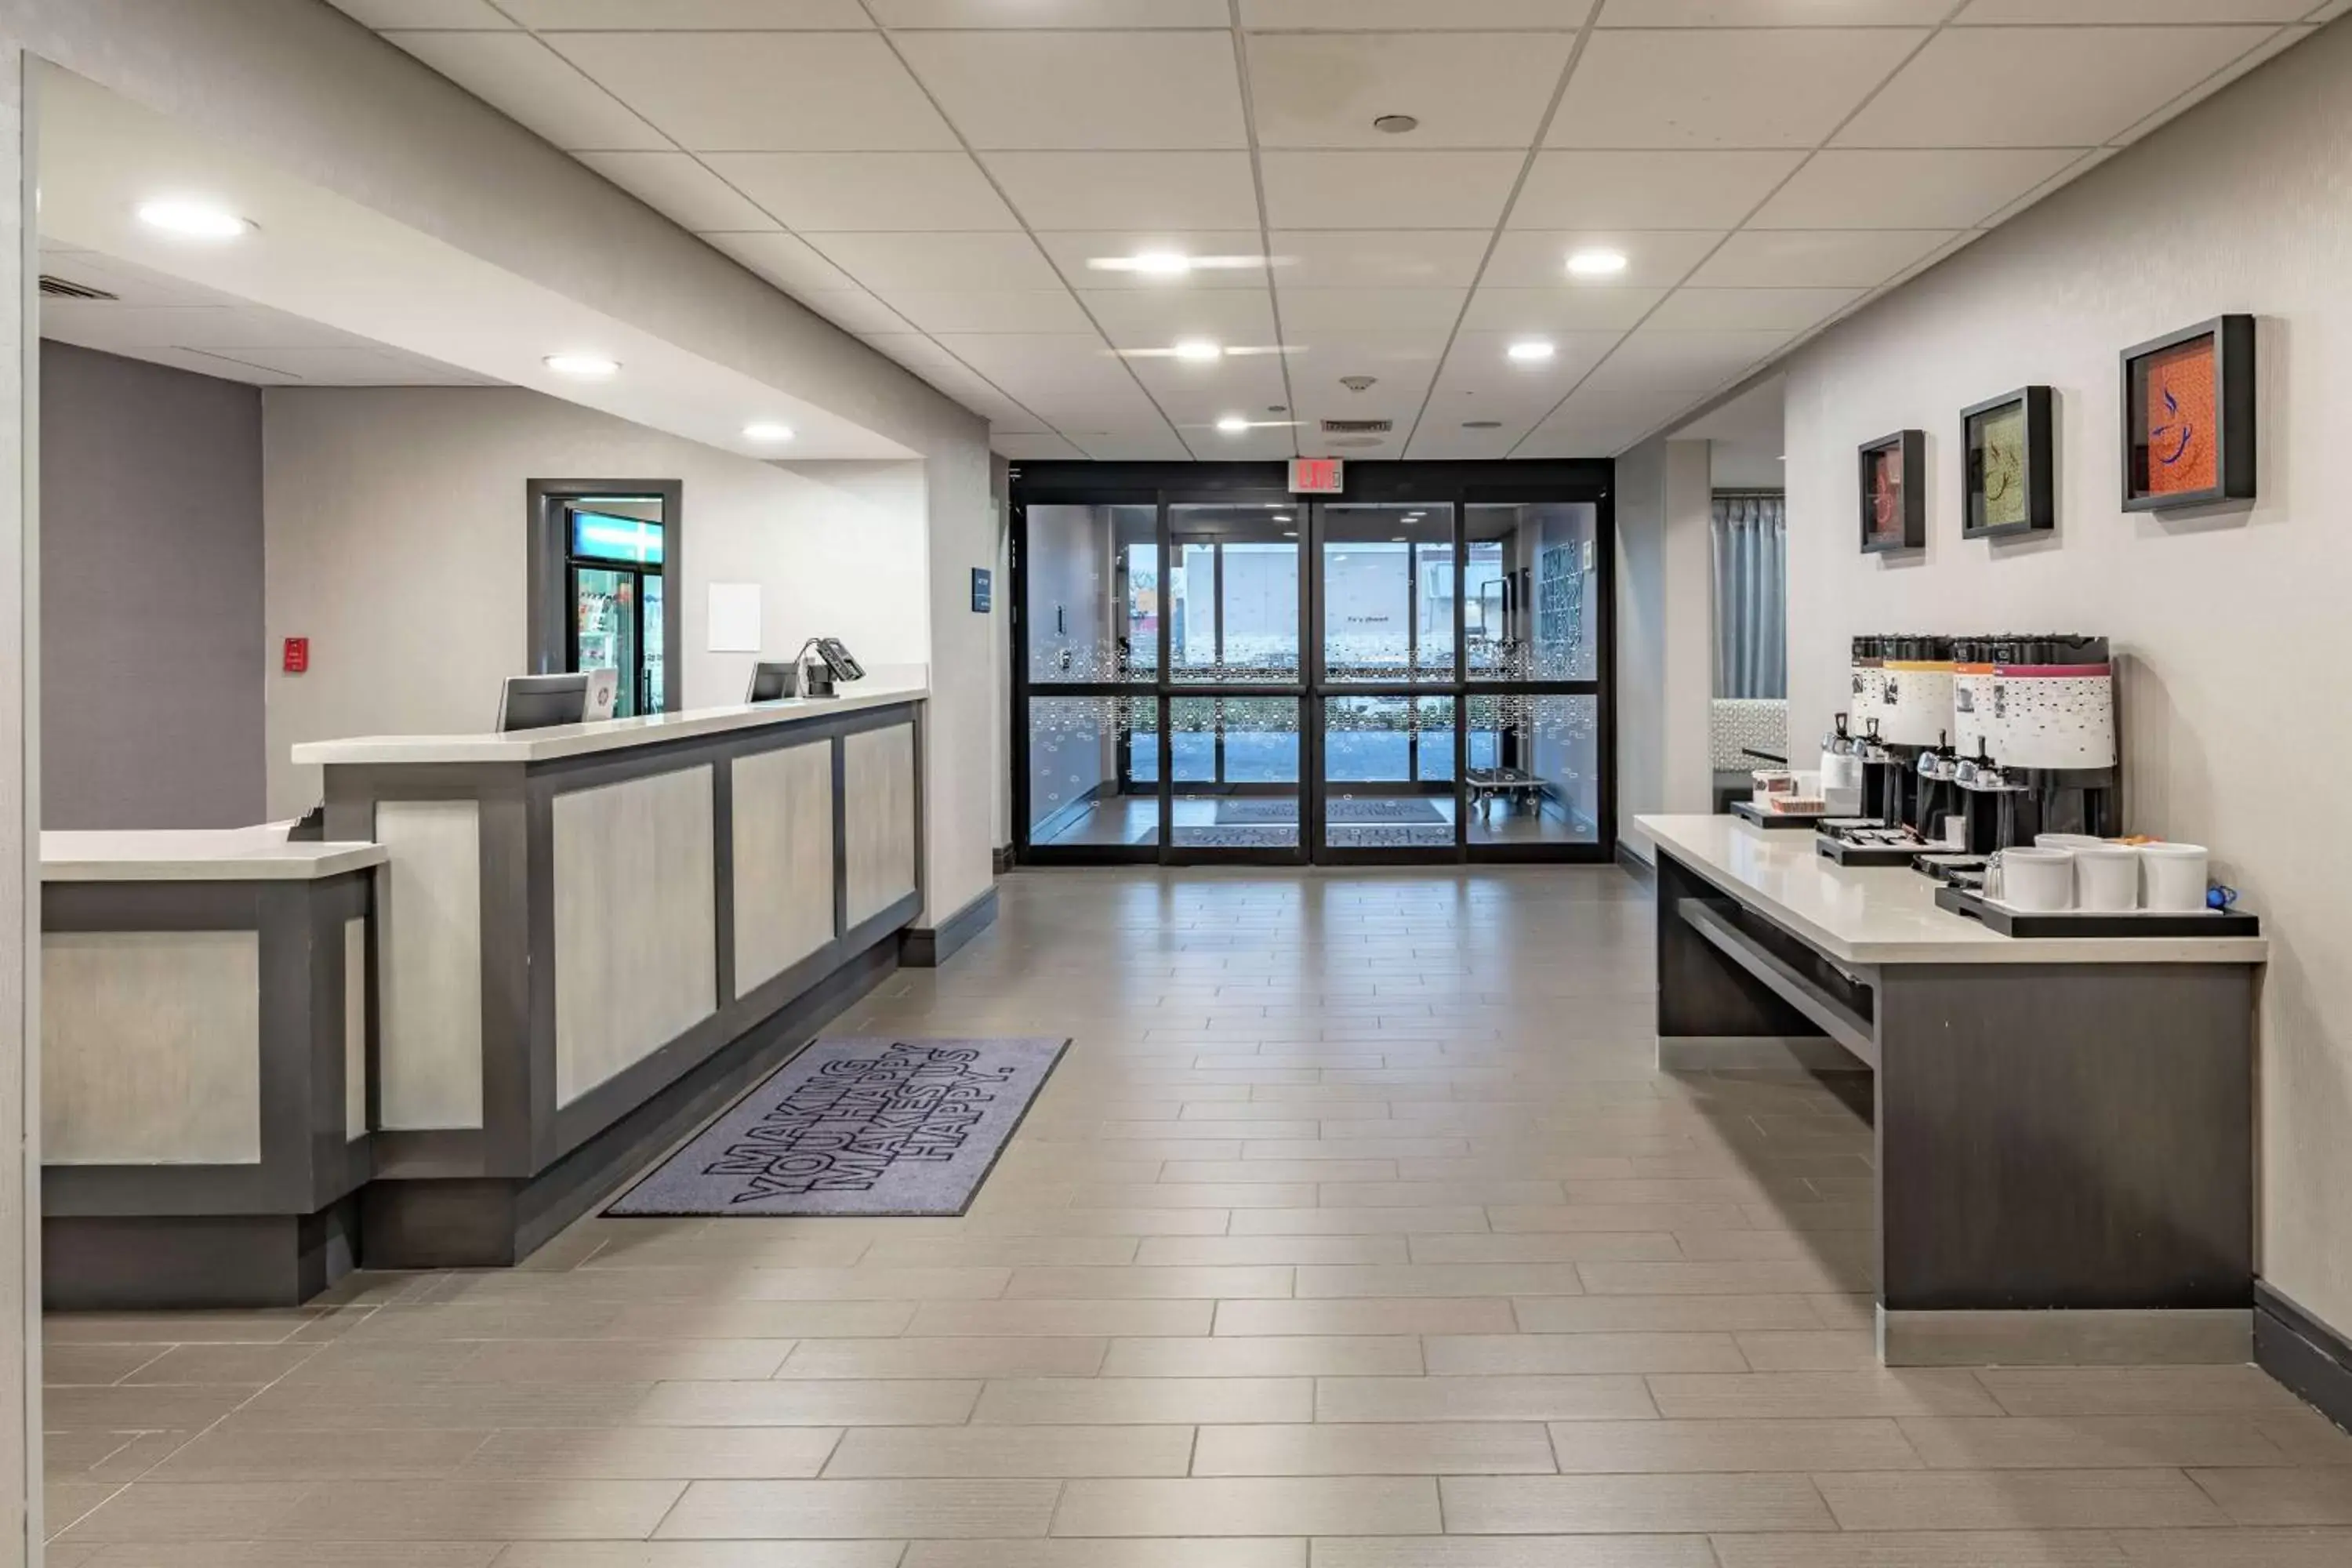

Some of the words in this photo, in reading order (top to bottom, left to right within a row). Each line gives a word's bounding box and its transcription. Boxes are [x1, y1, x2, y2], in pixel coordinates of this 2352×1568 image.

[702, 1060, 877, 1174] MAKING
[729, 1131, 856, 1204] YOU
[813, 1043, 935, 1123] HAPPY
[806, 1084, 950, 1190] MAKES
[911, 1048, 980, 1078] US
[892, 1067, 1015, 1161] HAPPY.
